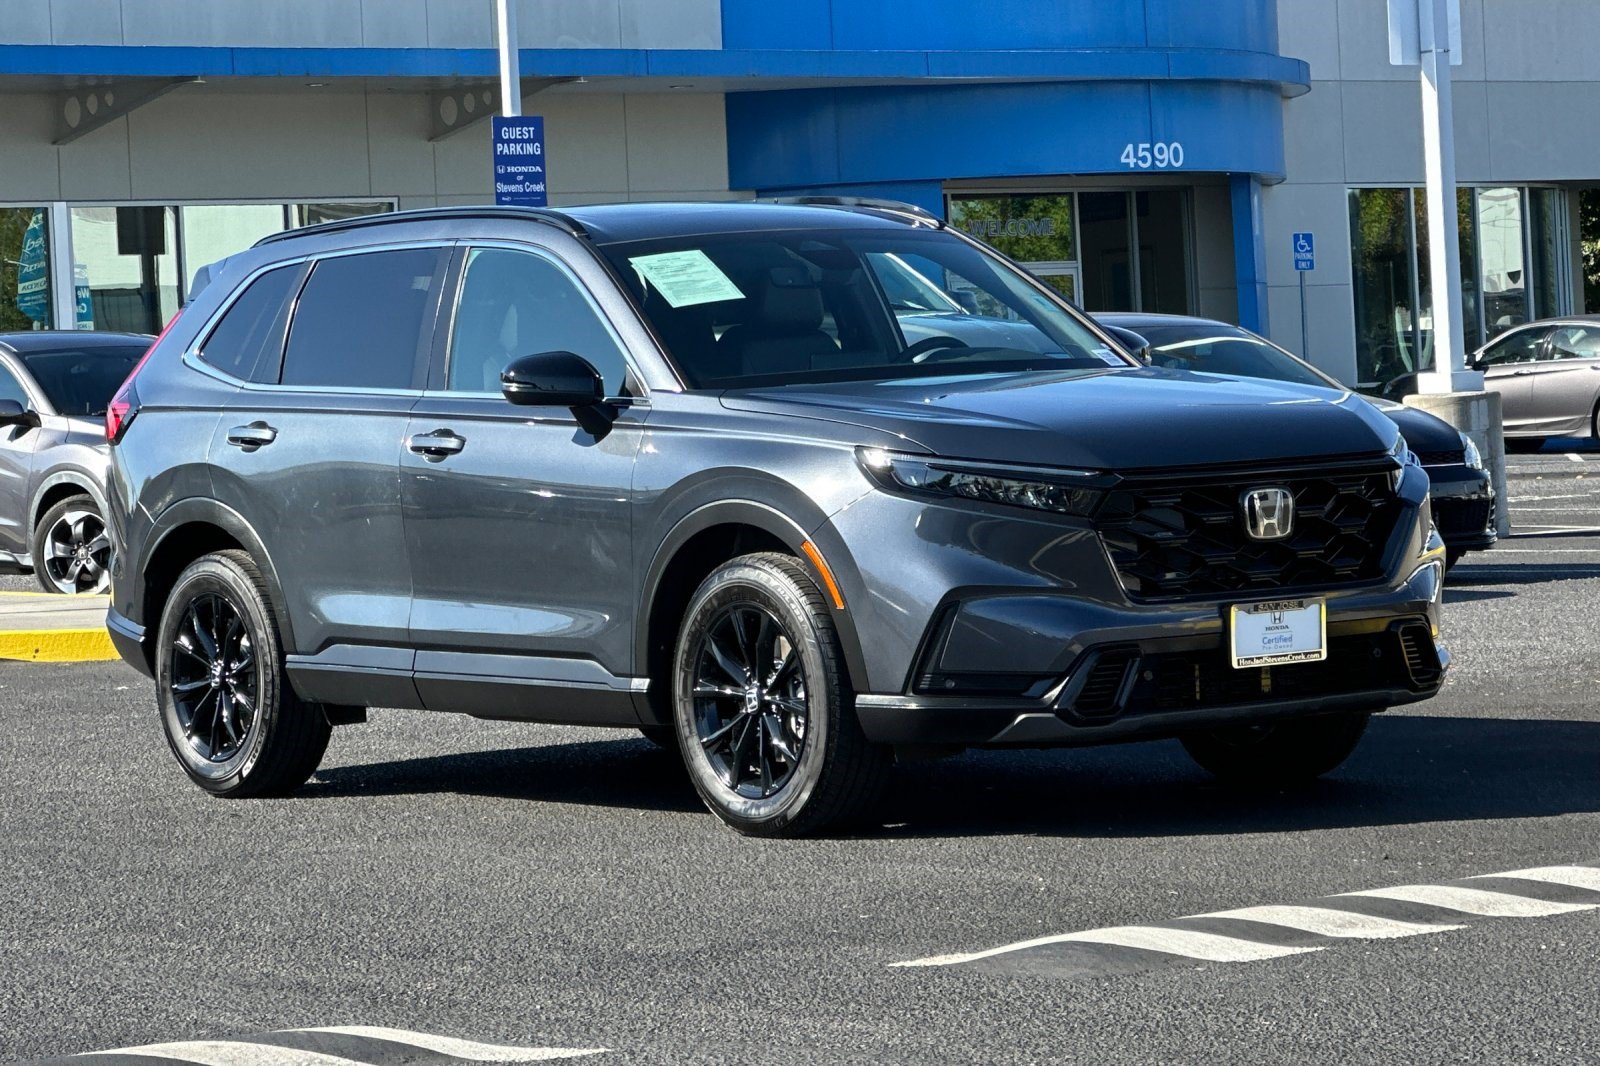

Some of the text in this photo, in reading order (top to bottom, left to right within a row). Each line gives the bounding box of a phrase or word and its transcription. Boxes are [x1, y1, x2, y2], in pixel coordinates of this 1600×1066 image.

[501, 126, 535, 139] GUEST
[496, 143, 541, 155] PARKING
[1120, 142, 1184, 168] 4590
[496, 182, 545, 193] Stevens Creek
[968, 217, 1056, 237] WELCOME
[1294, 252, 1313, 260] PARKING
[1298, 260, 1310, 269] ONLY
[1262, 634, 1293, 645] Certified
